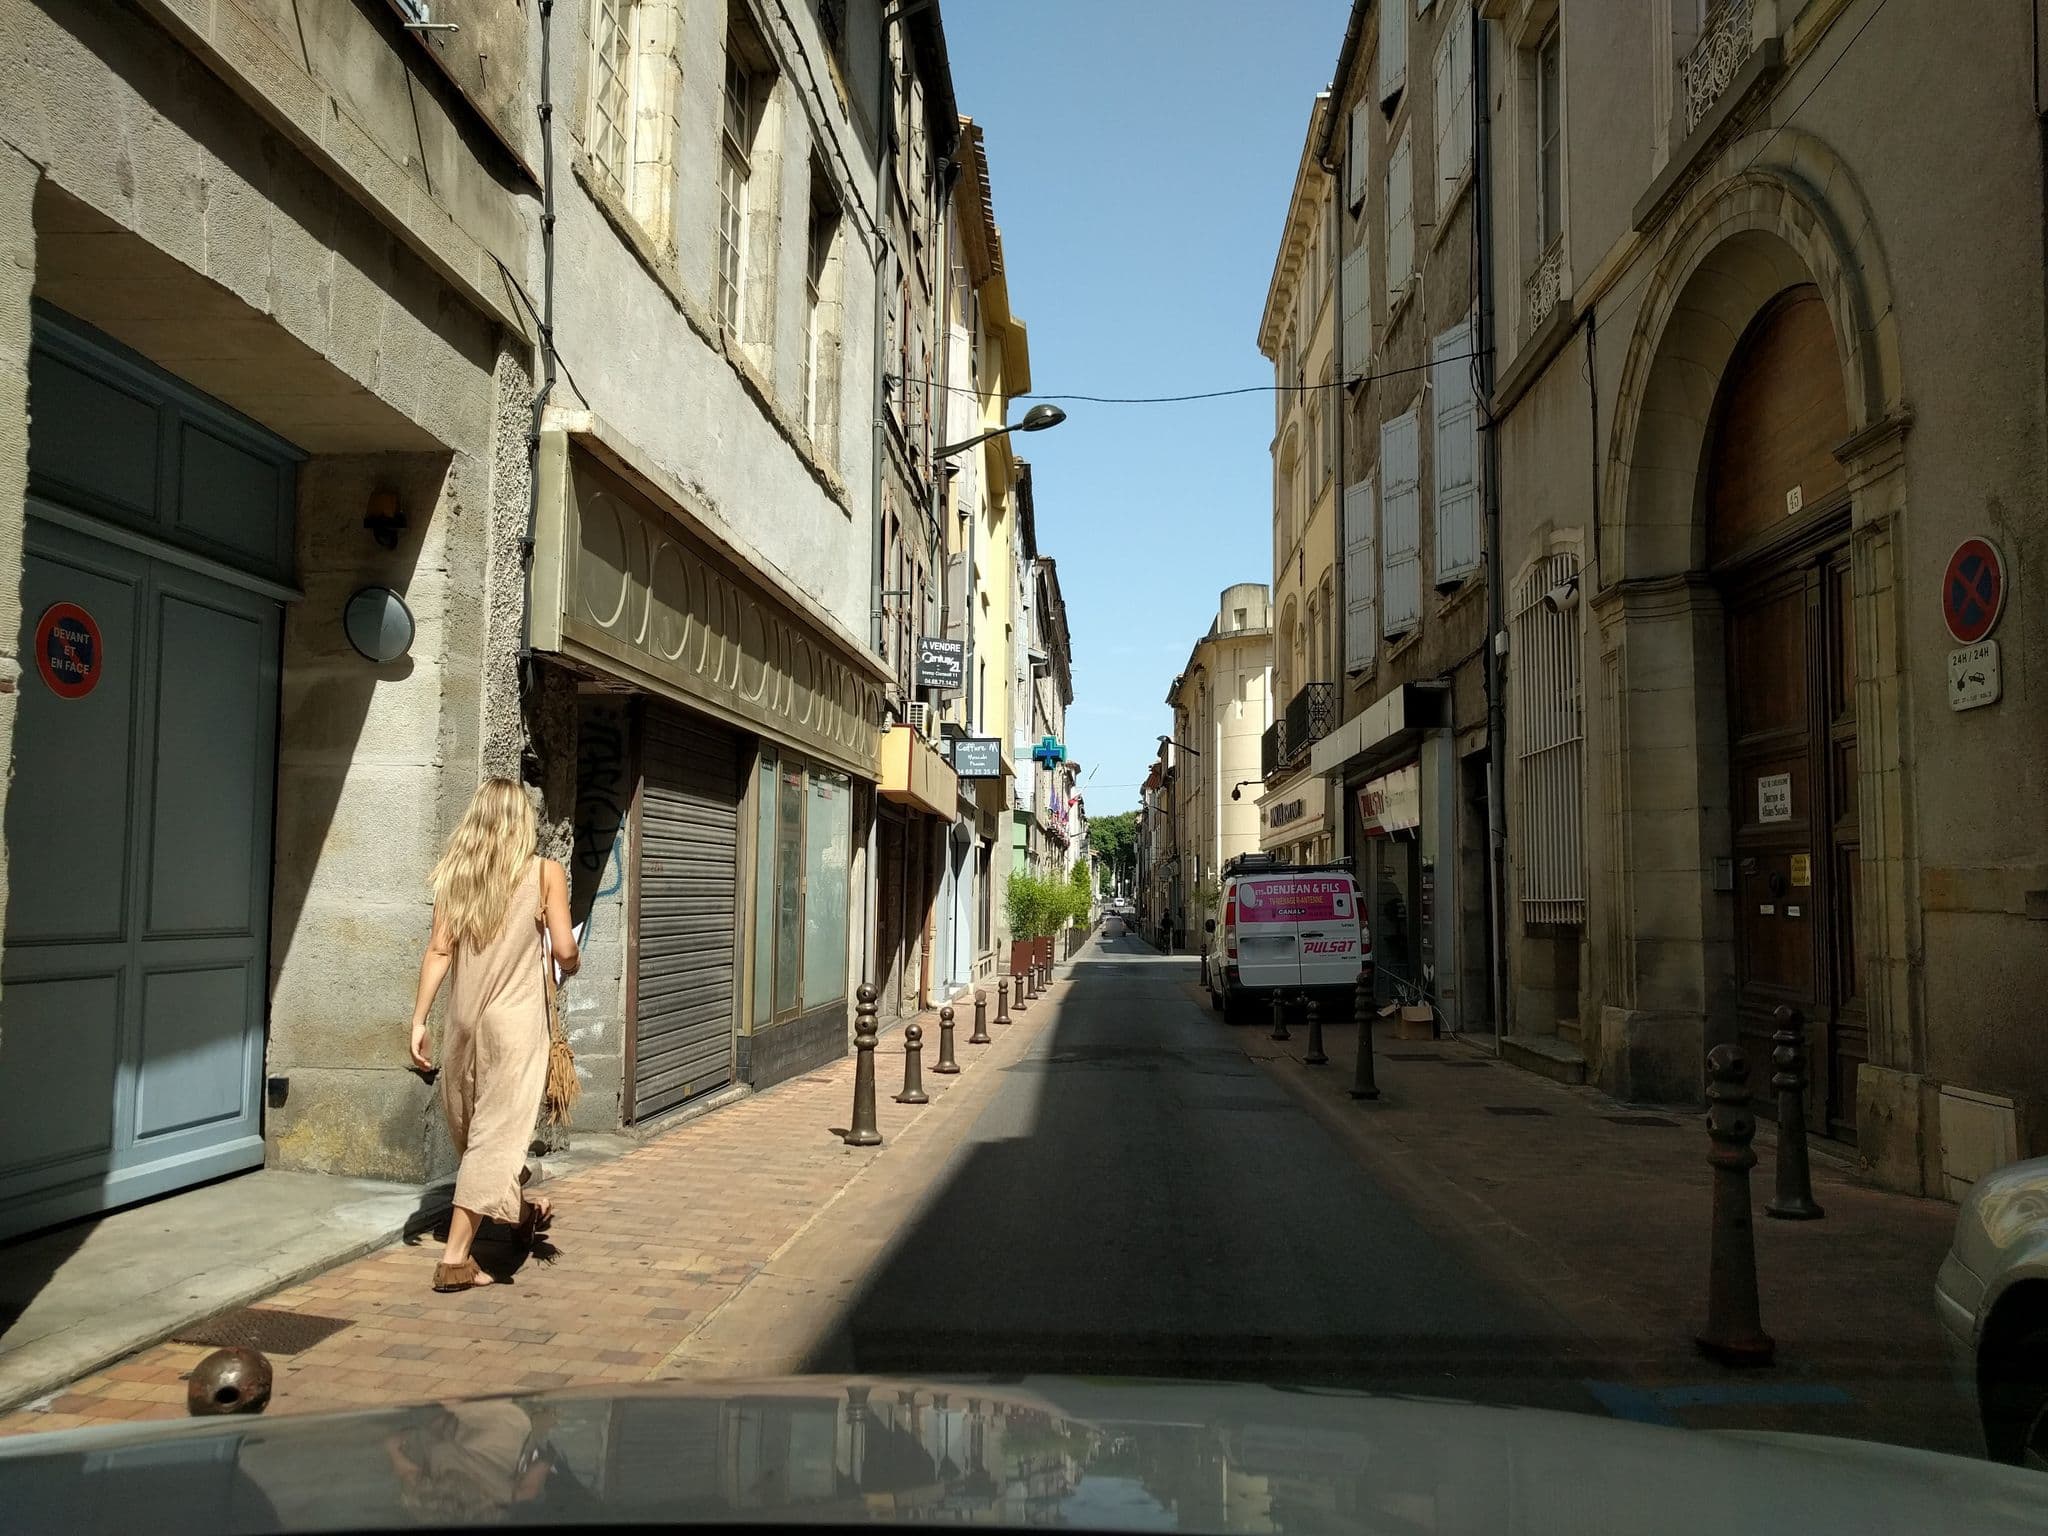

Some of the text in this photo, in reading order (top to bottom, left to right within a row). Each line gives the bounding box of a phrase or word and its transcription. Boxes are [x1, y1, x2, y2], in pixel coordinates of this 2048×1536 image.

[53, 626, 90, 645] DEVANT
[63, 645, 76, 656] ET
[921, 640, 961, 653] A VENDRE
[51, 657, 90, 675] EN FACE
[922, 651, 962, 673] Century 21
[1266, 884, 1311, 895] DENJEAN
[1312, 884, 1320, 894] &
[1321, 882, 1341, 893] FILS
